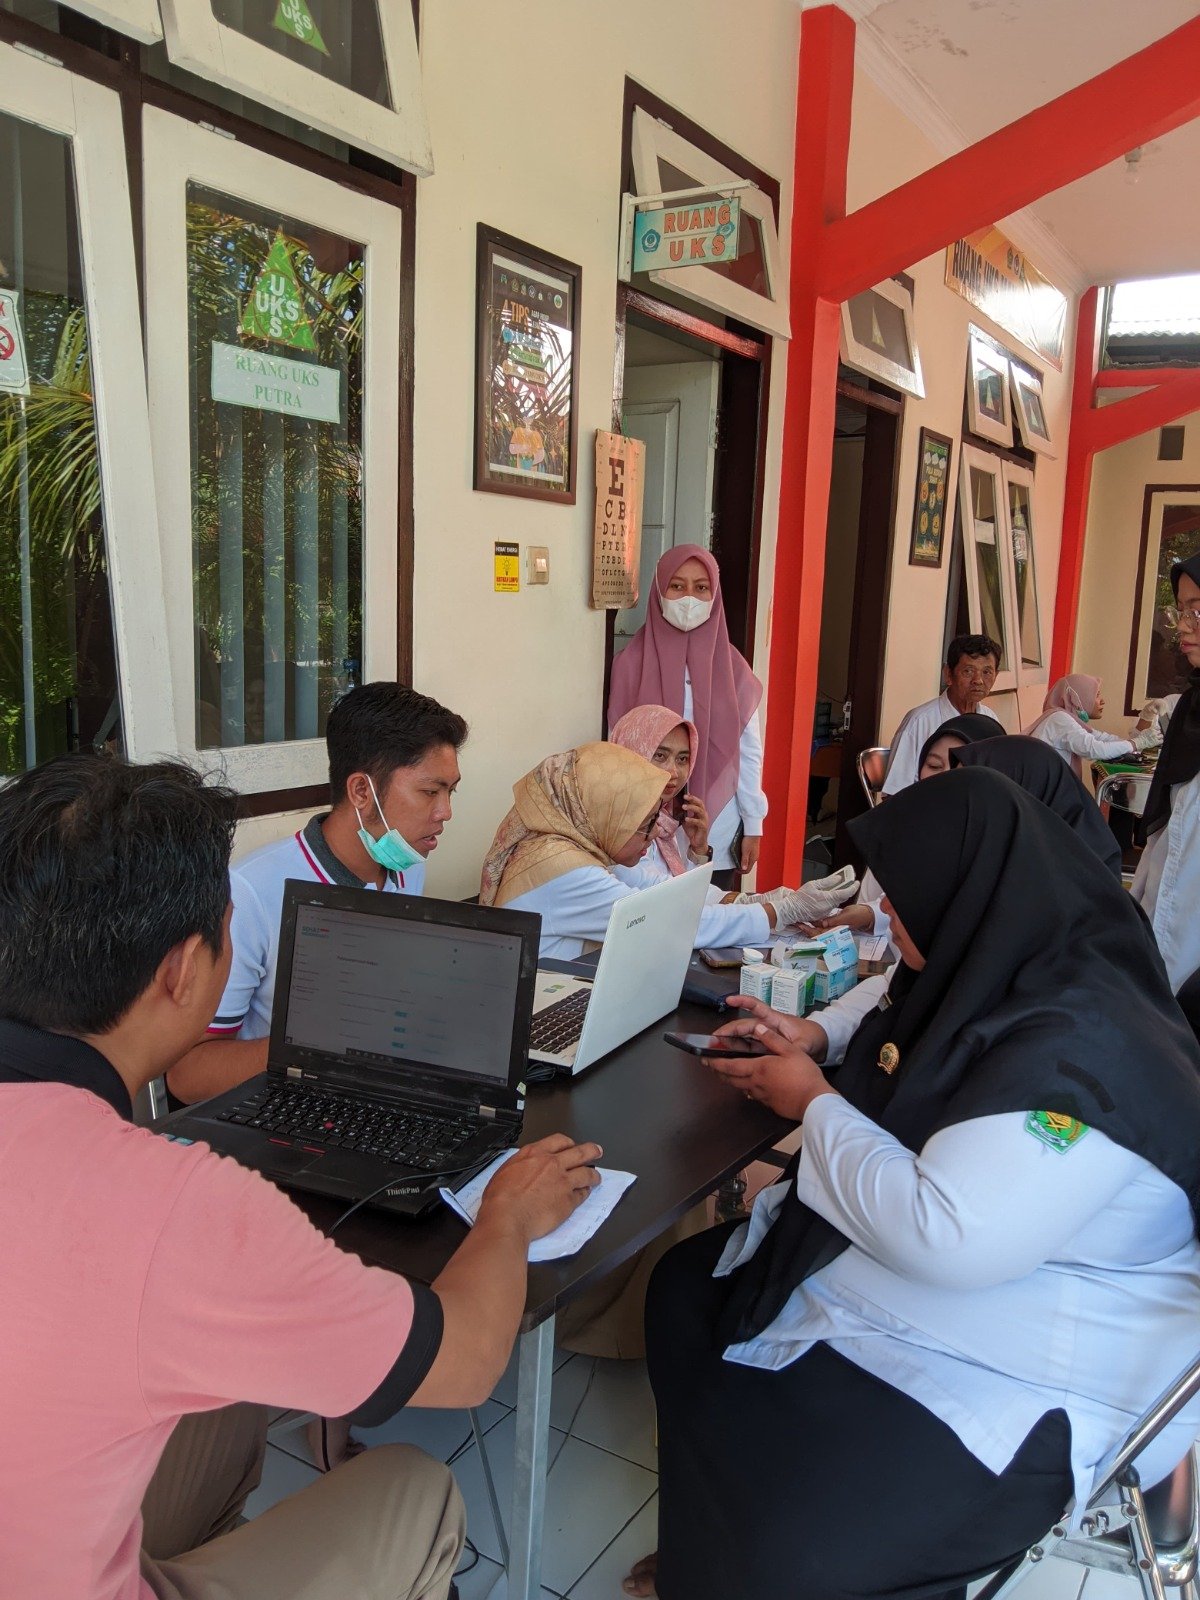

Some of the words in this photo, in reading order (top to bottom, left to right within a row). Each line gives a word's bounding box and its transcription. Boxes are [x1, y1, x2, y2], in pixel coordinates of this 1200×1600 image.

[663, 203, 731, 234] RUANG
[669, 235, 726, 262] UKS
[235, 354, 288, 381] RUANG
[292, 368, 320, 387] UKS
[254, 384, 302, 409] PUTRA
[608, 456, 625, 497] E
[626, 914, 646, 930] Lenovo
[386, 1186, 420, 1197] ThinkPad
